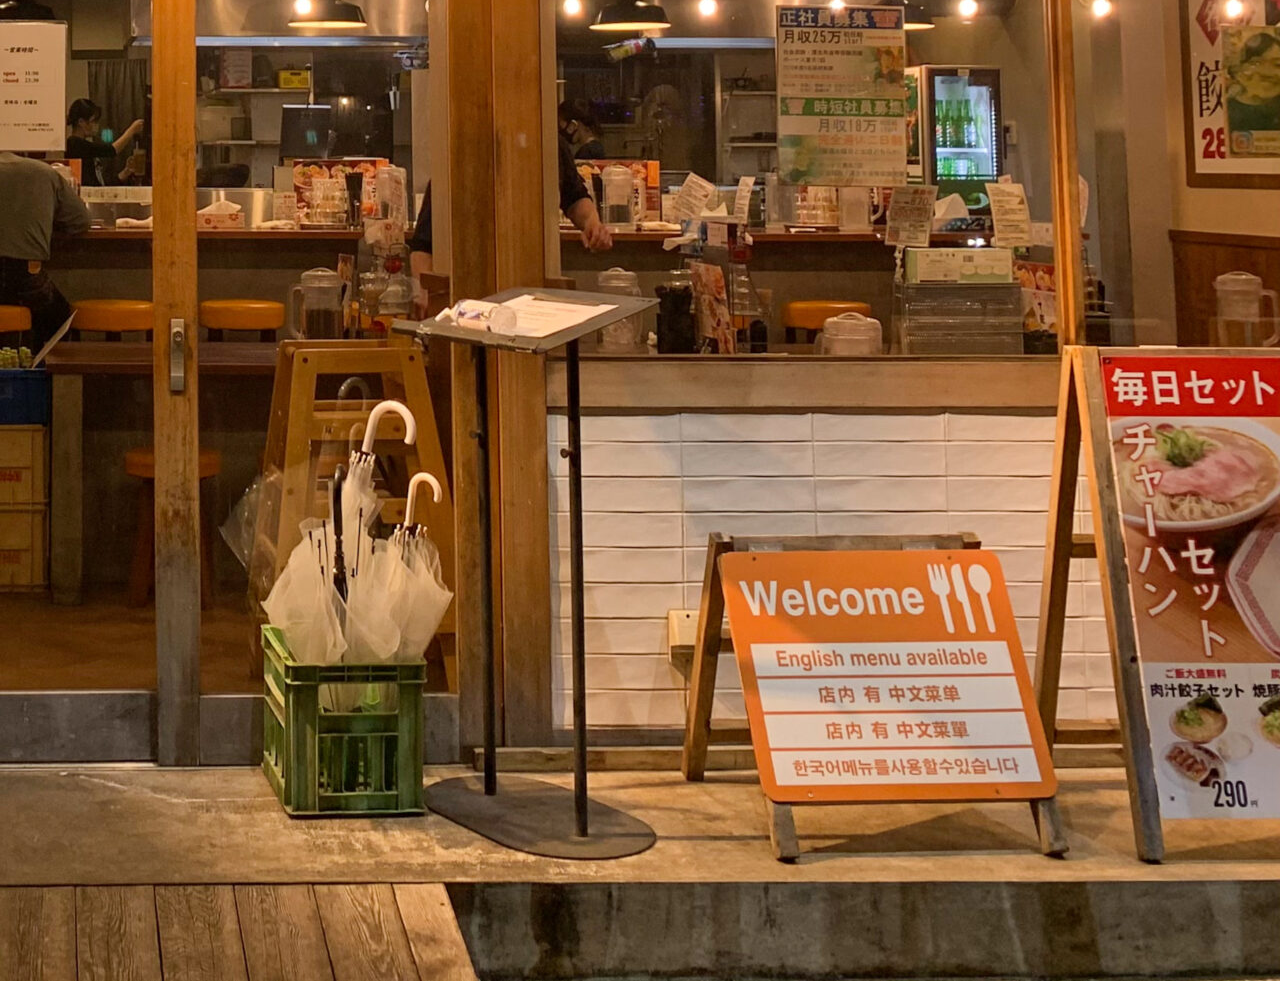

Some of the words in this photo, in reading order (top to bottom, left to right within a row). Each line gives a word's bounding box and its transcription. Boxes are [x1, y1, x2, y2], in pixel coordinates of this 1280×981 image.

[781, 9, 869, 27] 正社員募集
[783, 29, 841, 44] 月収25万
[814, 100, 904, 115] 時短社員募集
[818, 118, 877, 133] 月収18万
[1111, 367, 1276, 407] 毎日セット
[1123, 422, 1178, 618] チャーハン
[738, 580, 925, 617] Welcome
[1180, 539, 1227, 657] セット
[776, 649, 844, 672] English
[851, 652, 901, 667] menu
[907, 648, 988, 666] available
[818, 686, 856, 704] 店内
[863, 686, 881, 704] 有
[889, 685, 961, 703] 中文菜单
[1150, 683, 1245, 698] 肉汁餃子セット
[826, 722, 864, 740] 店内
[871, 722, 889, 740] 有
[897, 721, 970, 739] 中文菜單
[792, 758, 1019, 778] 한국어메뉴를사용할수있습니다
